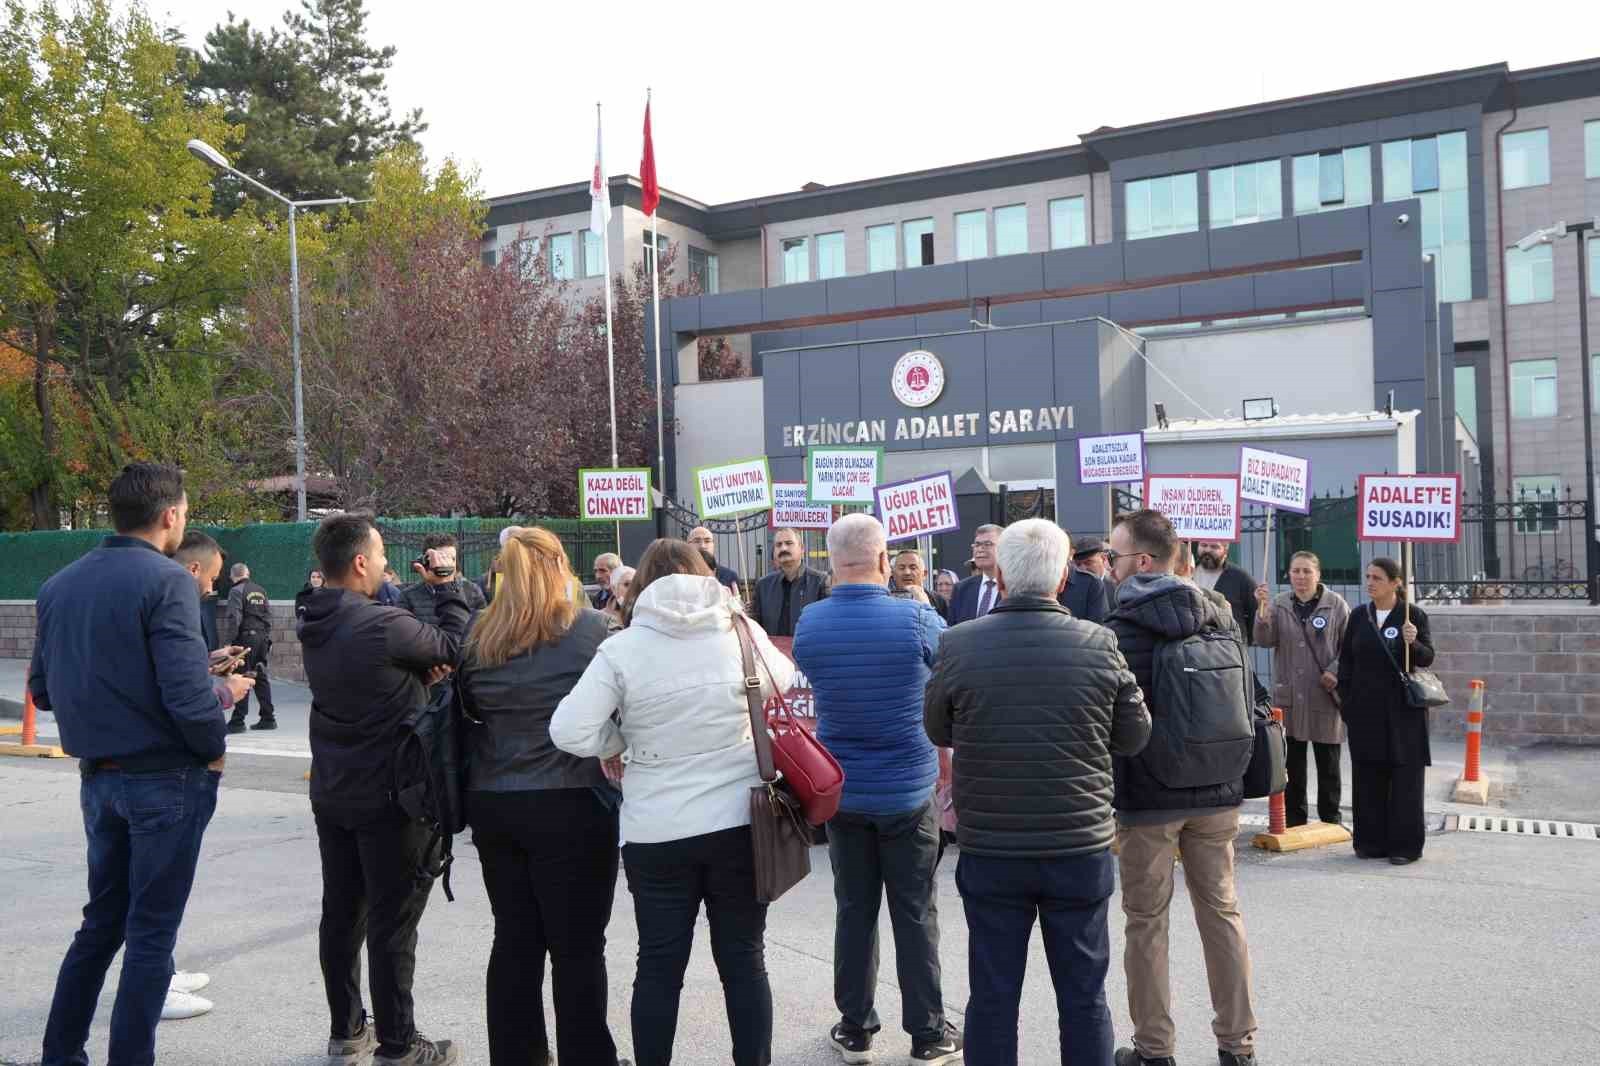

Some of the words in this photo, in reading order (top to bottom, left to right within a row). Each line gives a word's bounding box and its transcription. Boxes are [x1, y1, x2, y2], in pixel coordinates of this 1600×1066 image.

[783, 417, 886, 447] ERZİNCAN
[894, 413, 980, 441] ADALET
[989, 406, 1074, 434] SARAYI
[816, 456, 833, 469] BUGÜN
[845, 457, 875, 469] OLMAZSAK
[1084, 455, 1096, 466] SON
[726, 469, 764, 488] UNUTMA
[817, 471, 834, 482] YARIN
[1262, 461, 1301, 483] BURADAYIZ
[588, 478, 613, 491] KAZA
[616, 475, 644, 491] DEĞİL
[1242, 475, 1270, 497] ADALET
[1271, 481, 1304, 503] NEREDE?
[706, 487, 764, 510] UNUTTURMA!
[884, 489, 920, 511] UĞUR
[921, 482, 947, 505] İÇİN
[1161, 485, 1186, 502] İNSANI
[1368, 486, 1452, 504] ADALET'E
[588, 492, 645, 515] CİNAYET!
[1180, 502, 1232, 517] KATLEDENLER
[889, 503, 952, 537] ADALET!
[1194, 517, 1233, 533] KALACAK?
[1368, 509, 1451, 529] SUSADIK!
